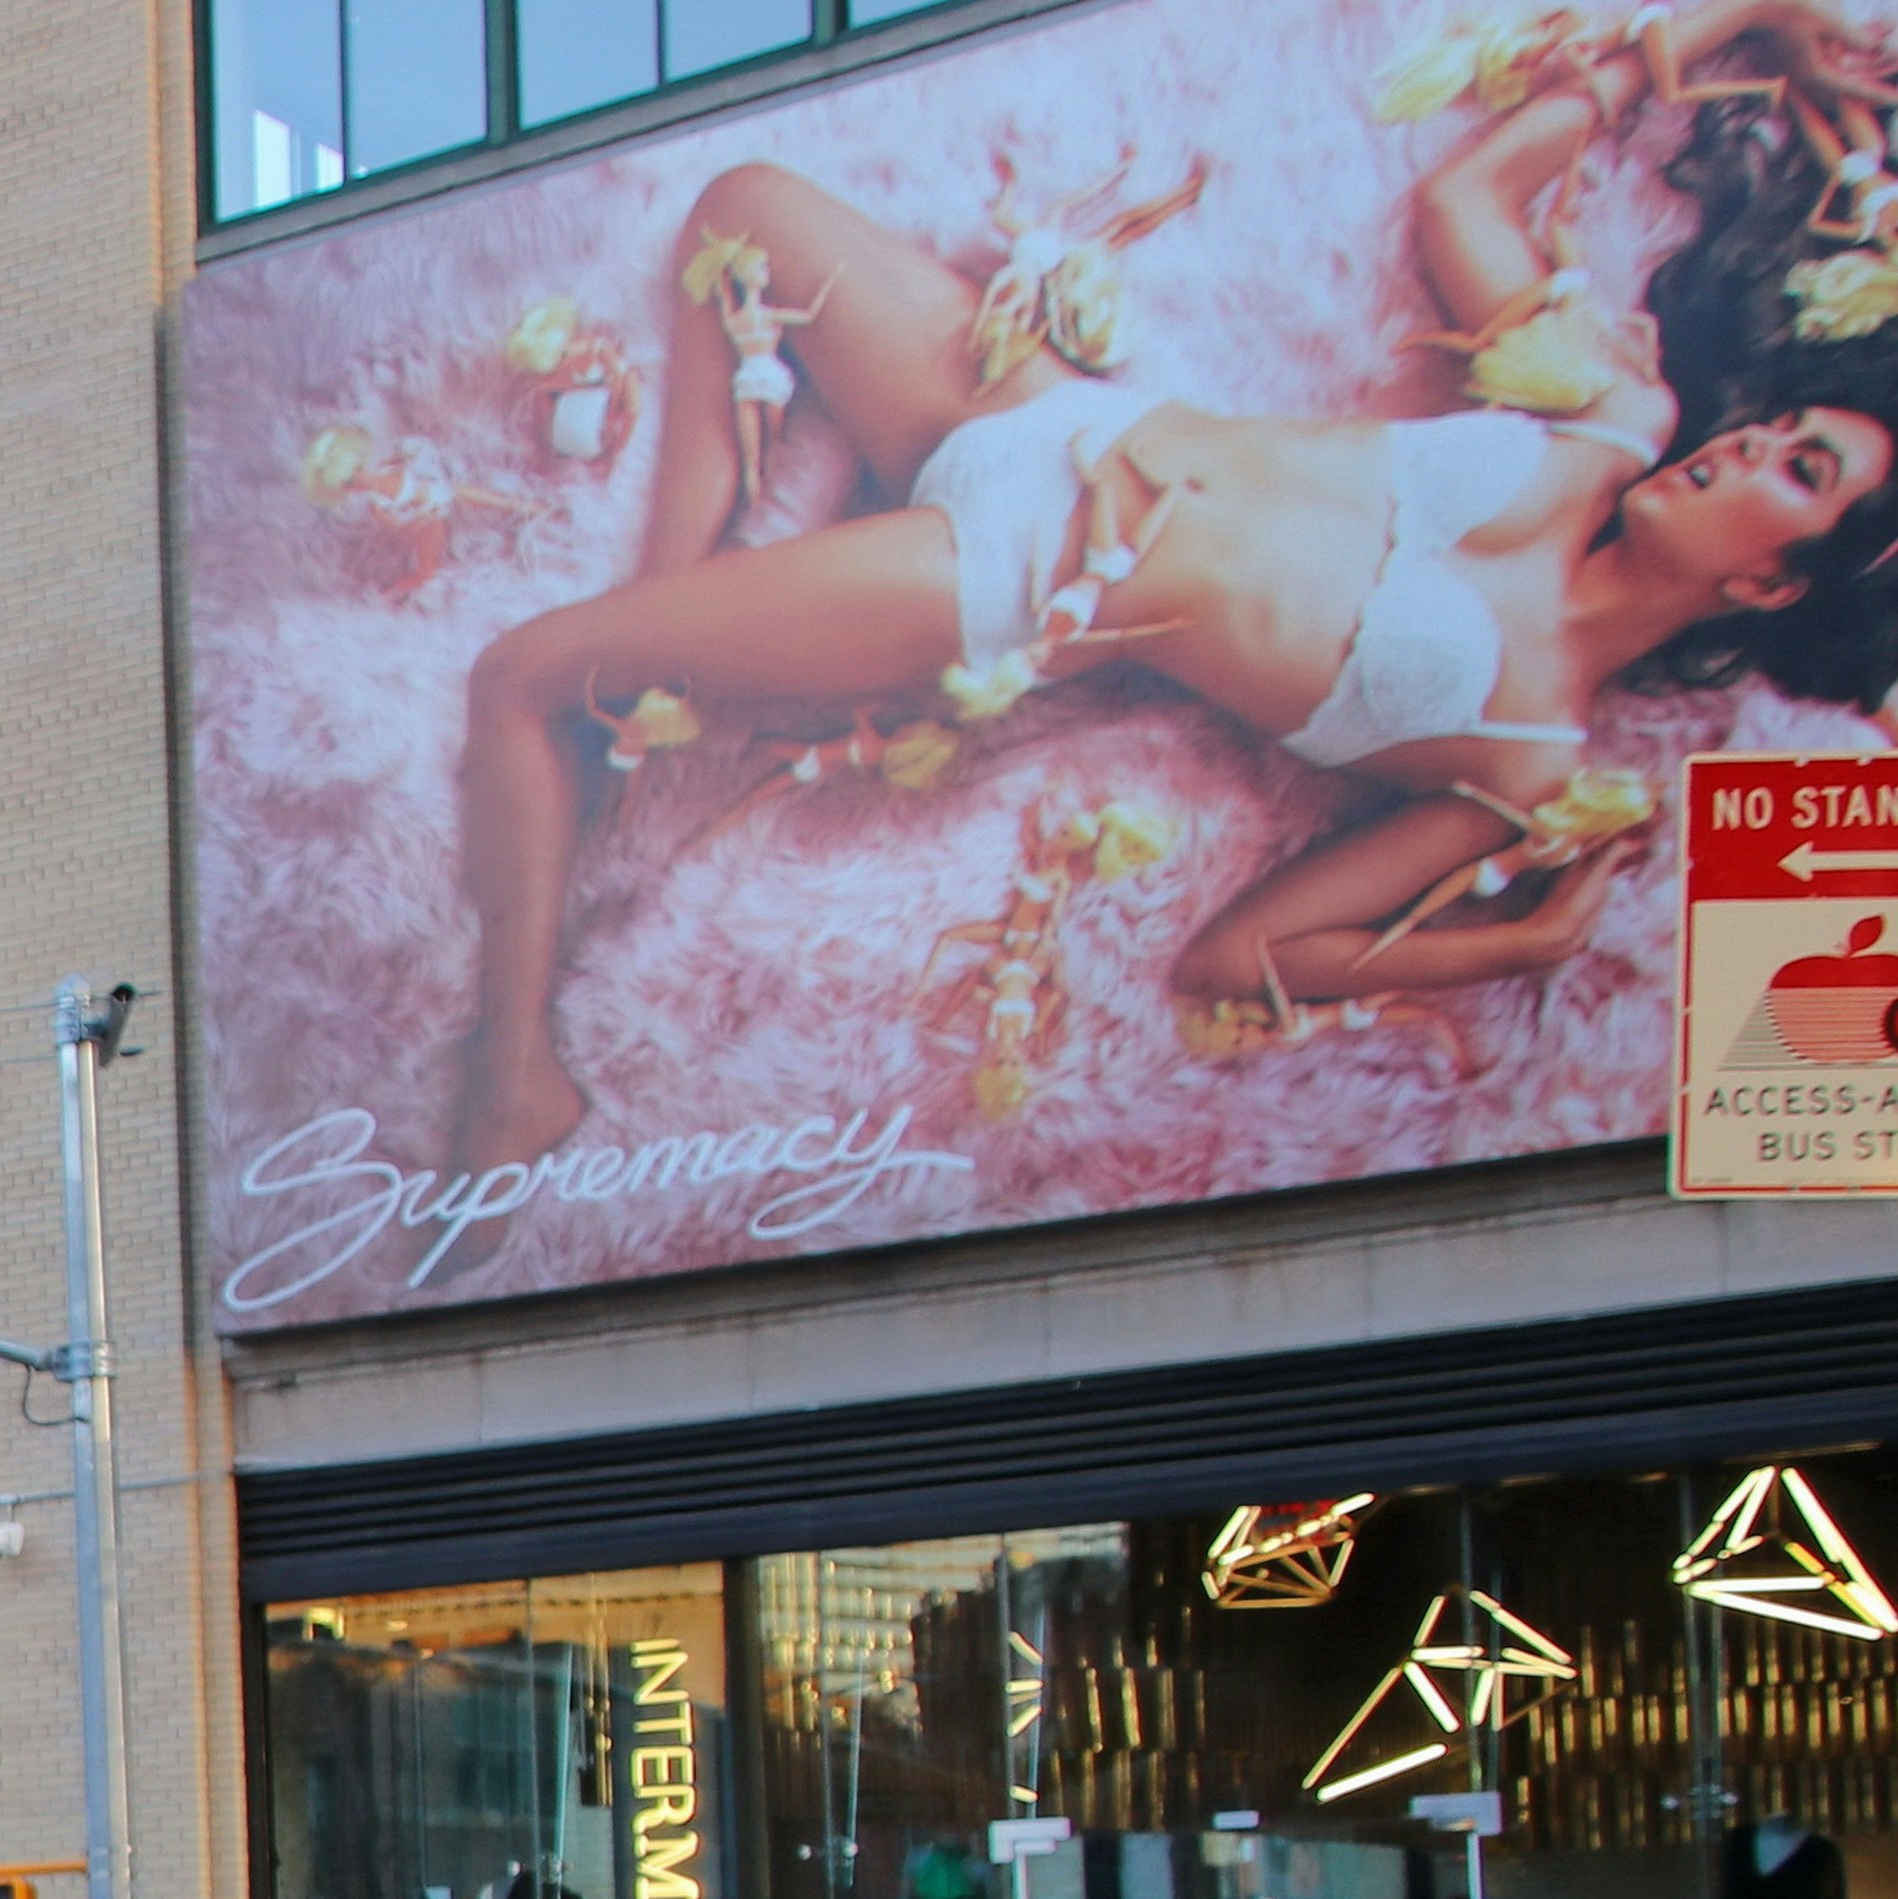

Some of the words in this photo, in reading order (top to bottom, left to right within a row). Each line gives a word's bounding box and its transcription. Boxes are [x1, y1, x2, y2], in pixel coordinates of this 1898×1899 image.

[1712, 786, 1774, 831] NO
[1759, 1131, 1837, 1163] BUS
[224, 1105, 974, 1313] Supremacy
